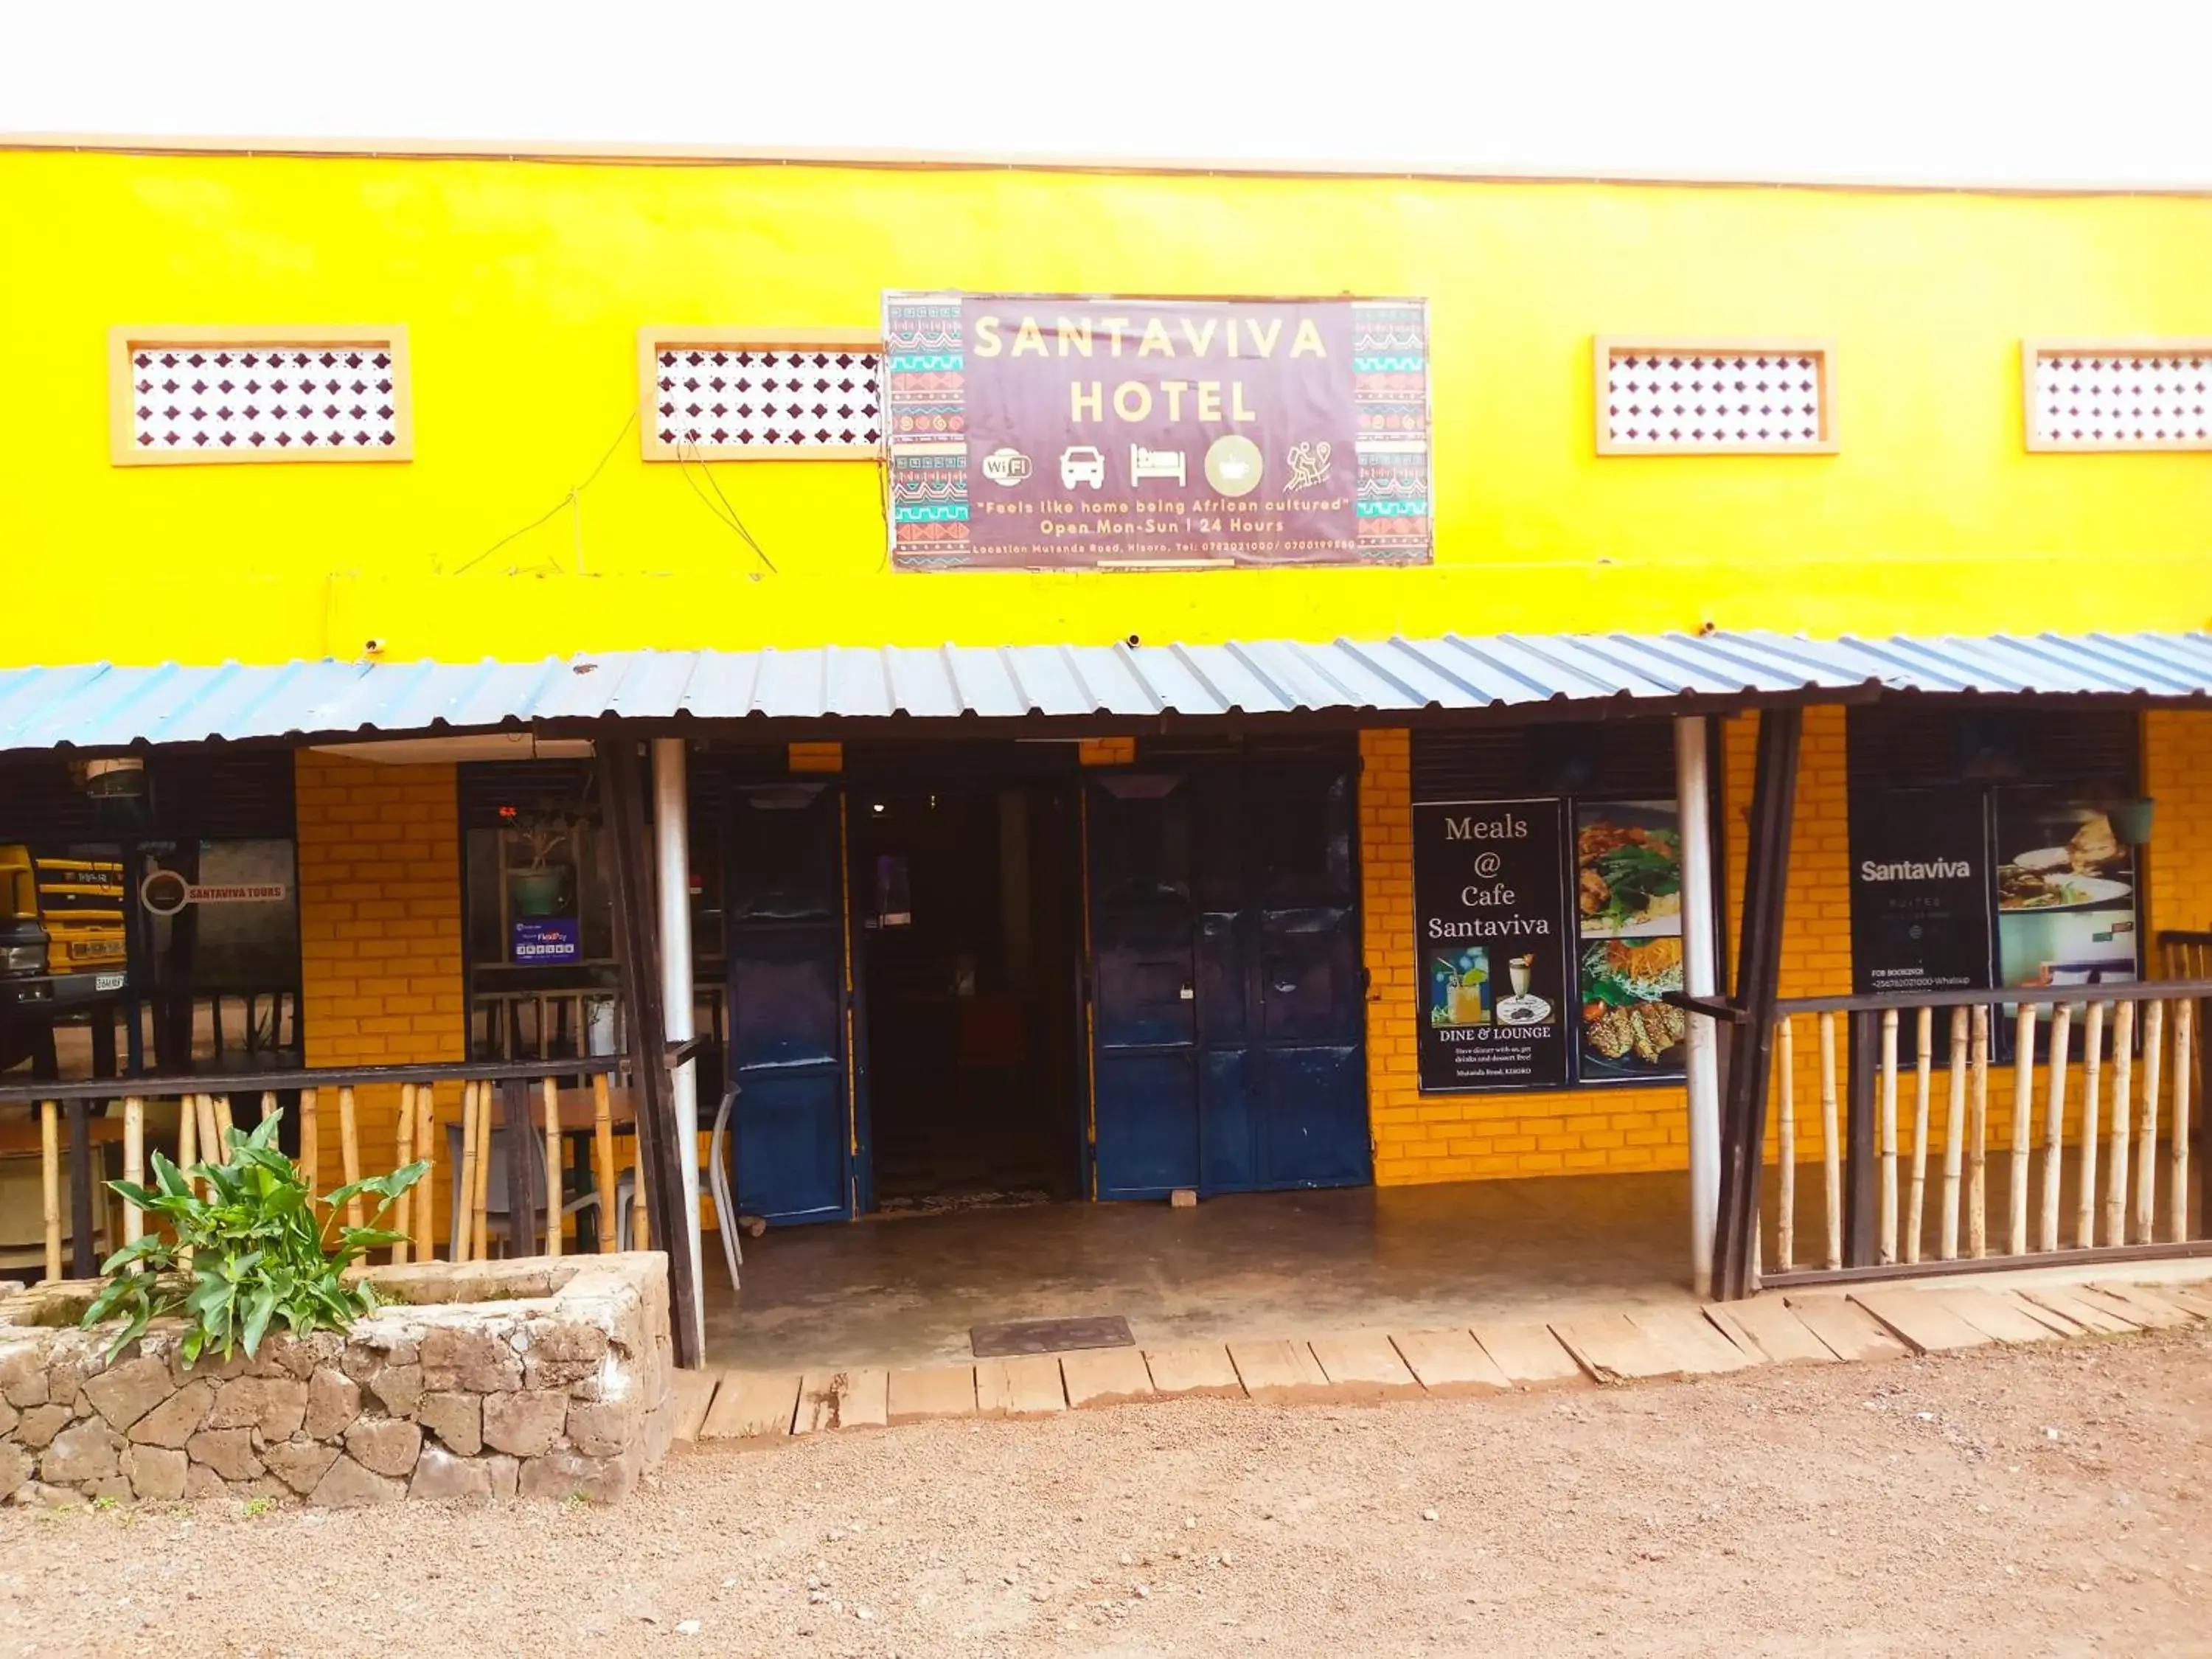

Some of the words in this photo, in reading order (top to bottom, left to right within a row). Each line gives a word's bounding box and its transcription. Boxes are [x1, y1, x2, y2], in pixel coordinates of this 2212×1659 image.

[974, 316, 1327, 358] SANTAVIVA
[1071, 380, 1256, 422] HOTEL
[1040, 499, 1074, 514] like
[1082, 500, 1129, 514] home
[1136, 499, 1185, 515] being
[1192, 499, 1258, 512] African
[1265, 498, 1349, 512] cultured"
[1040, 519, 1088, 538] Open
[1097, 518, 1178, 533] Mon-Sun
[1199, 518, 1222, 532] 24
[1231, 518, 1284, 532] Hours
[972, 544, 1028, 554] Location
[1090, 544, 1124, 554] Road,
[1444, 813, 1528, 840] Meals
[1475, 852, 1500, 878] @
[1860, 857, 1970, 882] Santaviva
[189, 888, 246, 899] SANTAVIVA
[247, 886, 282, 898] TOURS
[1461, 883, 1516, 906] Cafe
[1428, 914, 1550, 939] Santaviva
[1439, 1029, 1475, 1042] DINE
[1477, 1027, 1491, 1040] &
[1494, 1026, 1551, 1040] LOUNGE
